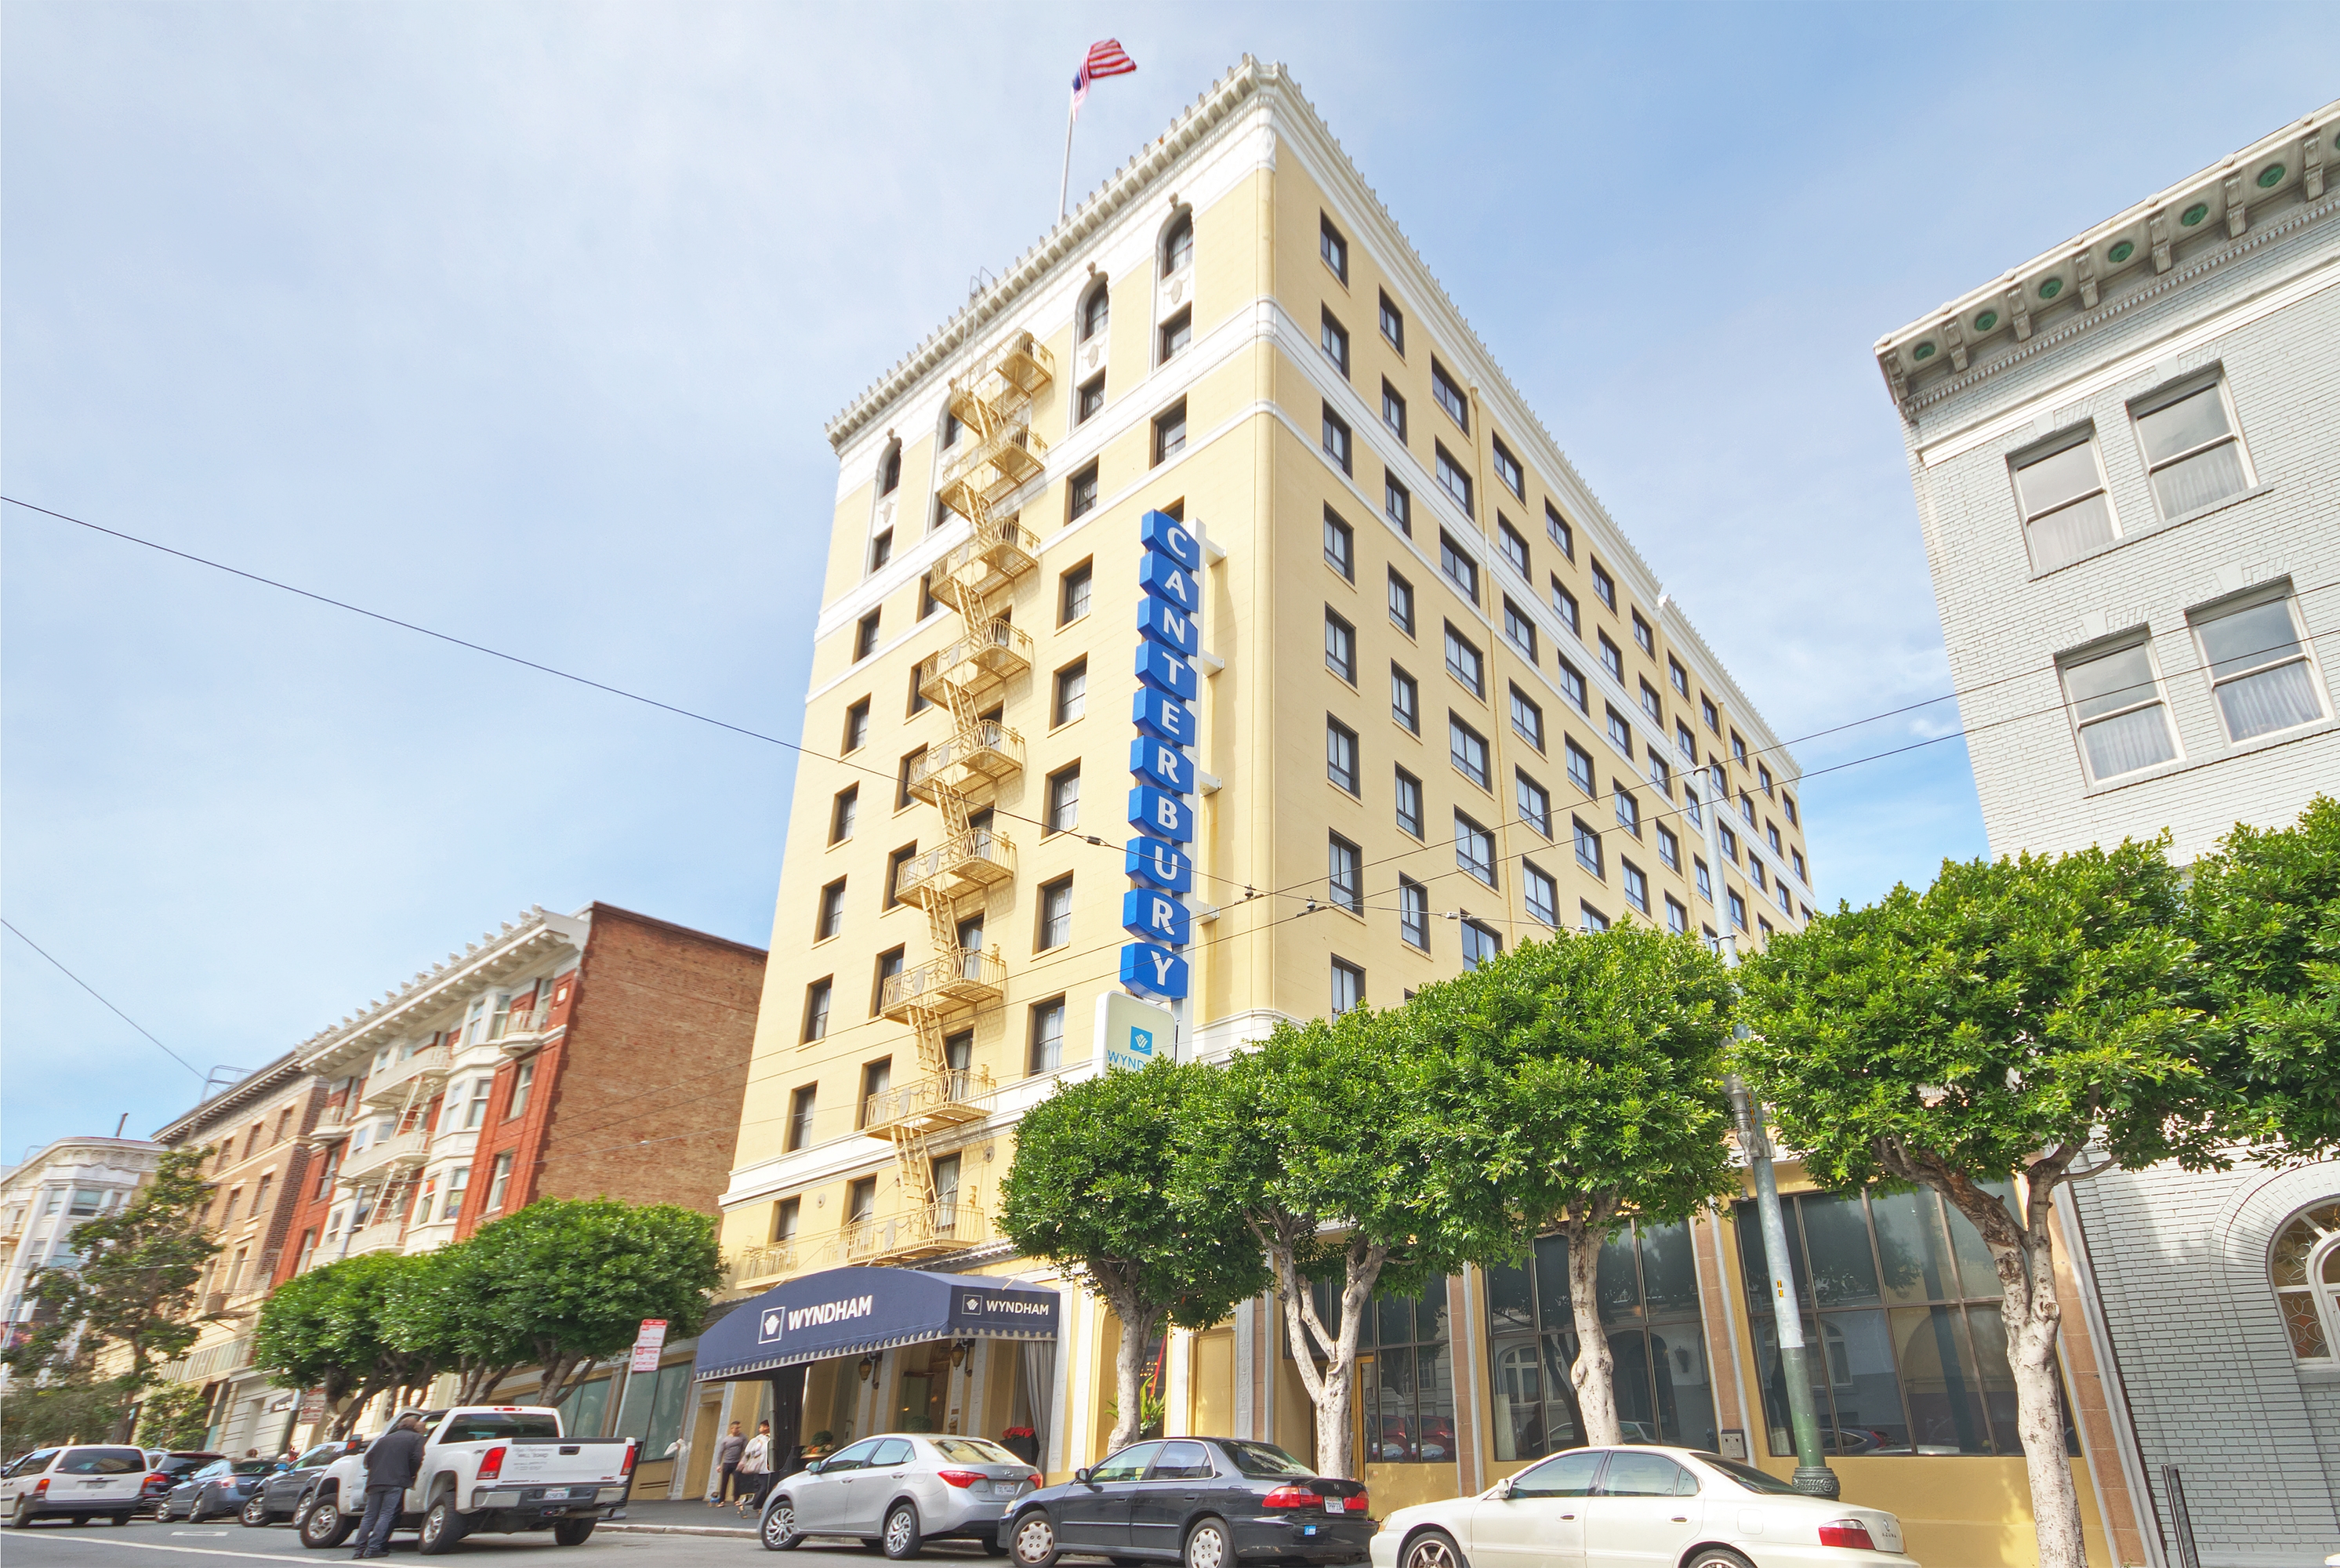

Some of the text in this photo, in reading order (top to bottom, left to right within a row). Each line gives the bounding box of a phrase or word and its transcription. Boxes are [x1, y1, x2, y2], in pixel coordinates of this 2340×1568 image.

[1150, 527, 1187, 986] CANTERBURY
[1108, 1049, 1145, 1071] WYND
[788, 1295, 873, 1330] WYNDHAM
[986, 1300, 1050, 1316] WYNDHAM
